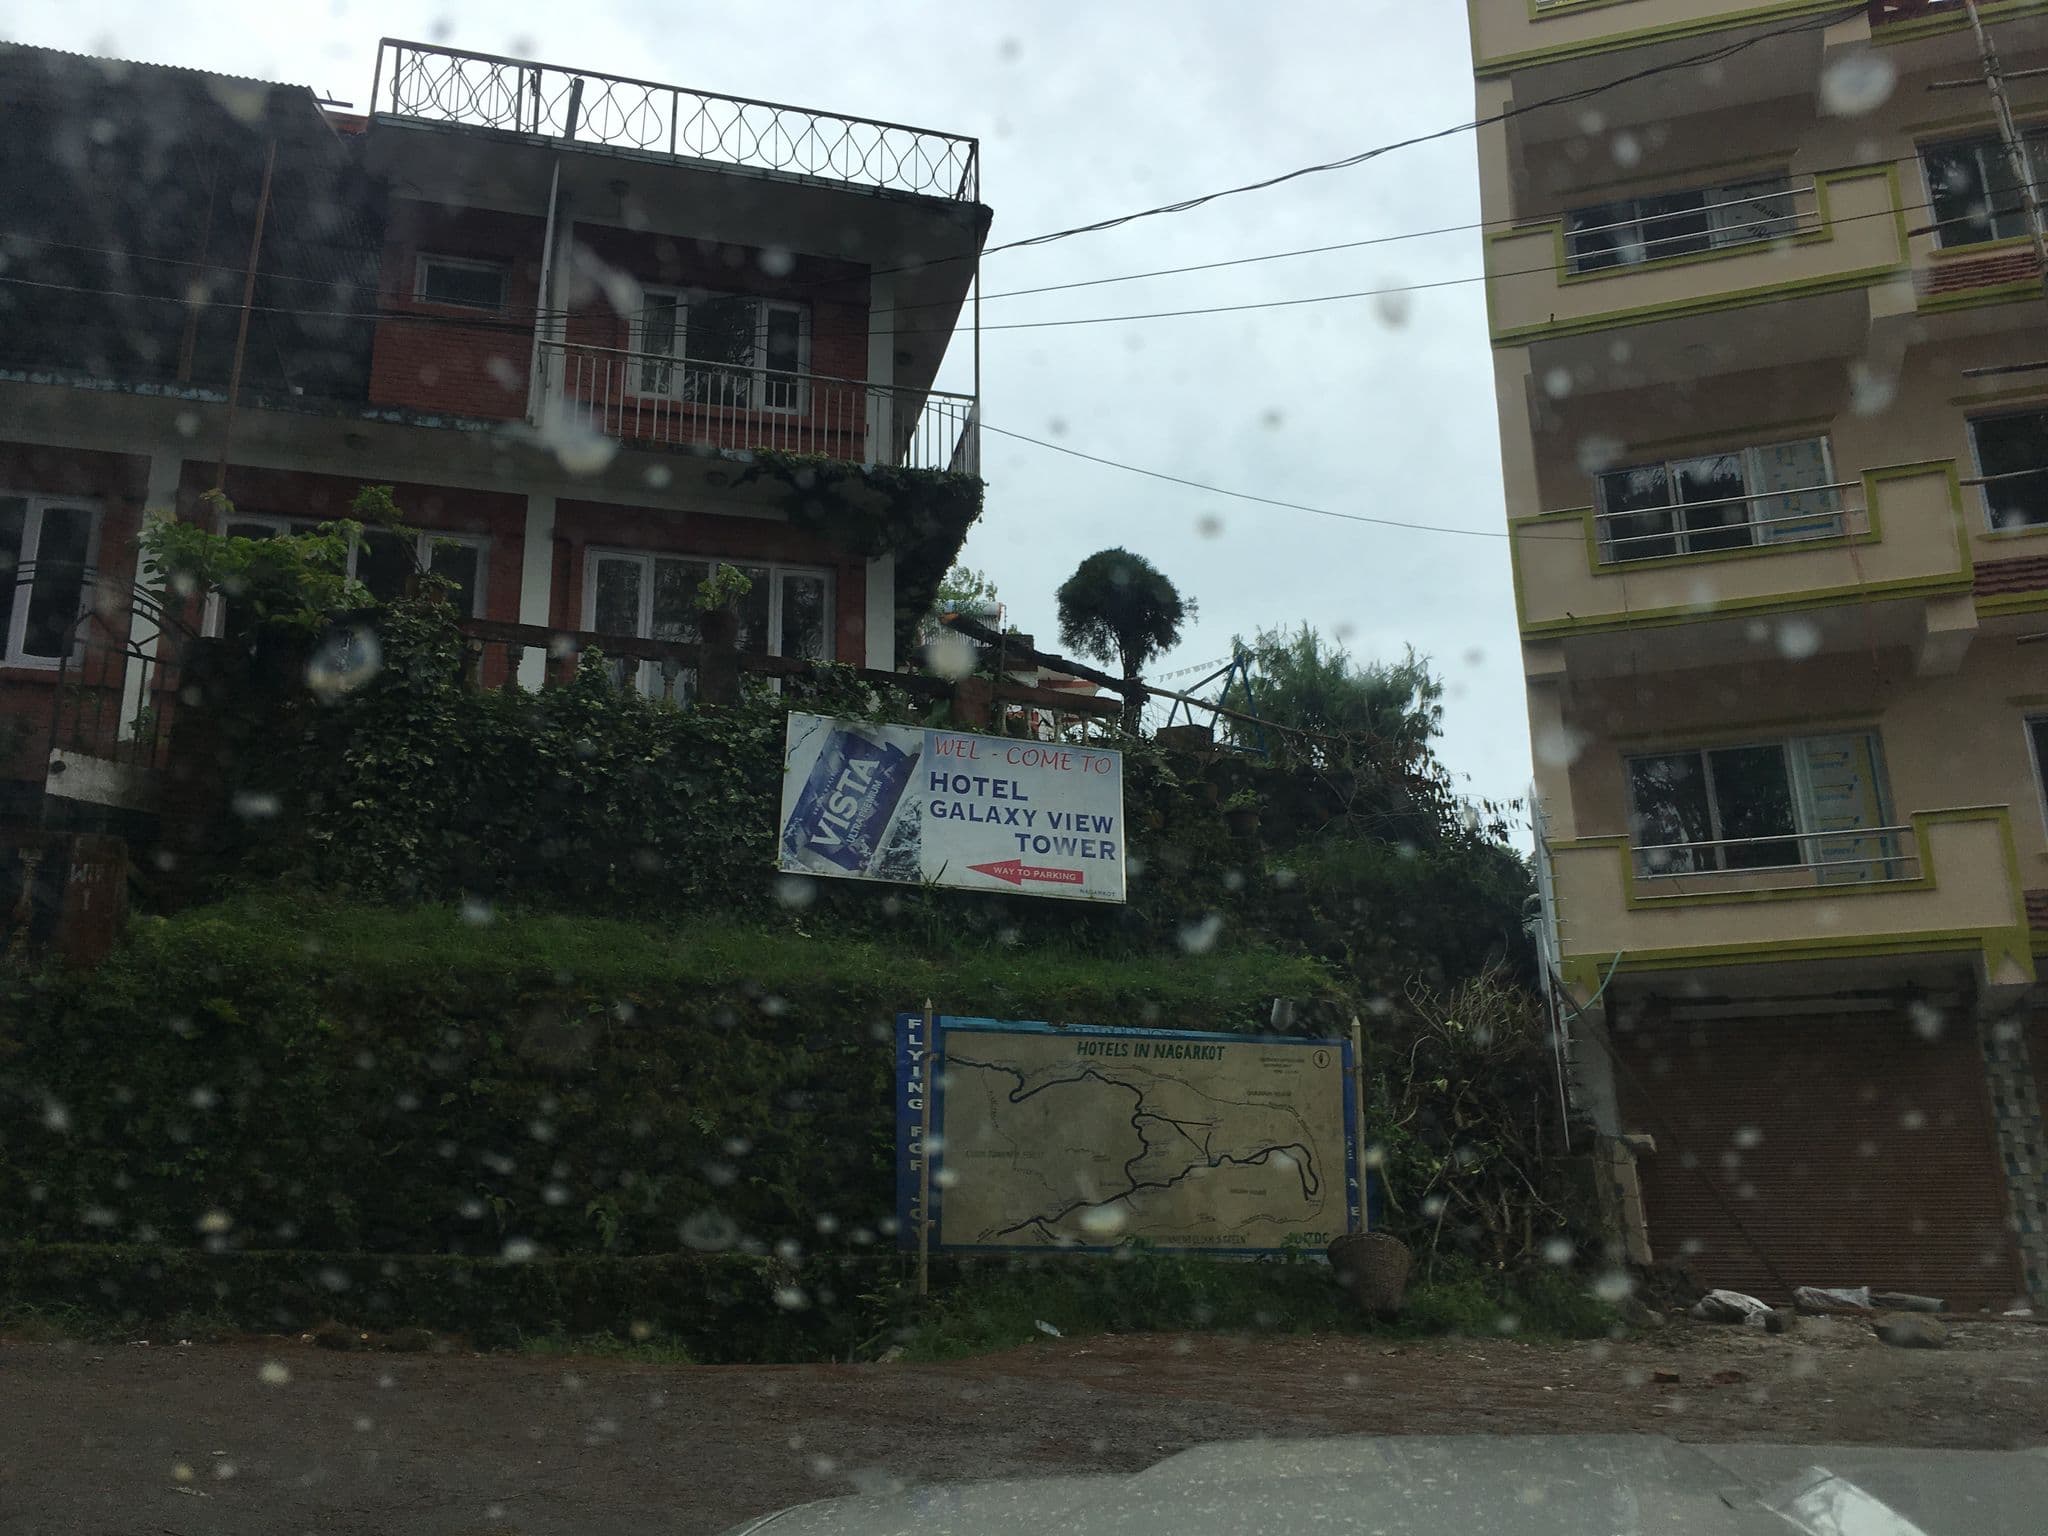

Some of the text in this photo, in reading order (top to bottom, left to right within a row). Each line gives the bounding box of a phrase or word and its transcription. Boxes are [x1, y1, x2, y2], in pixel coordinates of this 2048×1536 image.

[1006, 746, 1073, 771] COME
[1081, 755, 1112, 775] TO
[810, 758, 881, 845] VISTA
[929, 771, 1029, 802] HOTEL
[846, 779, 883, 843] ULTRA PREMIUM
[929, 799, 1114, 834] GALAXY VIEW
[1014, 832, 1116, 861] TOWER
[992, 865, 1077, 882] WAY TO PARKING
[907, 1018, 924, 1111] FLYING
[1076, 1041, 1226, 1062] HOTELS IN NAGARKOT
